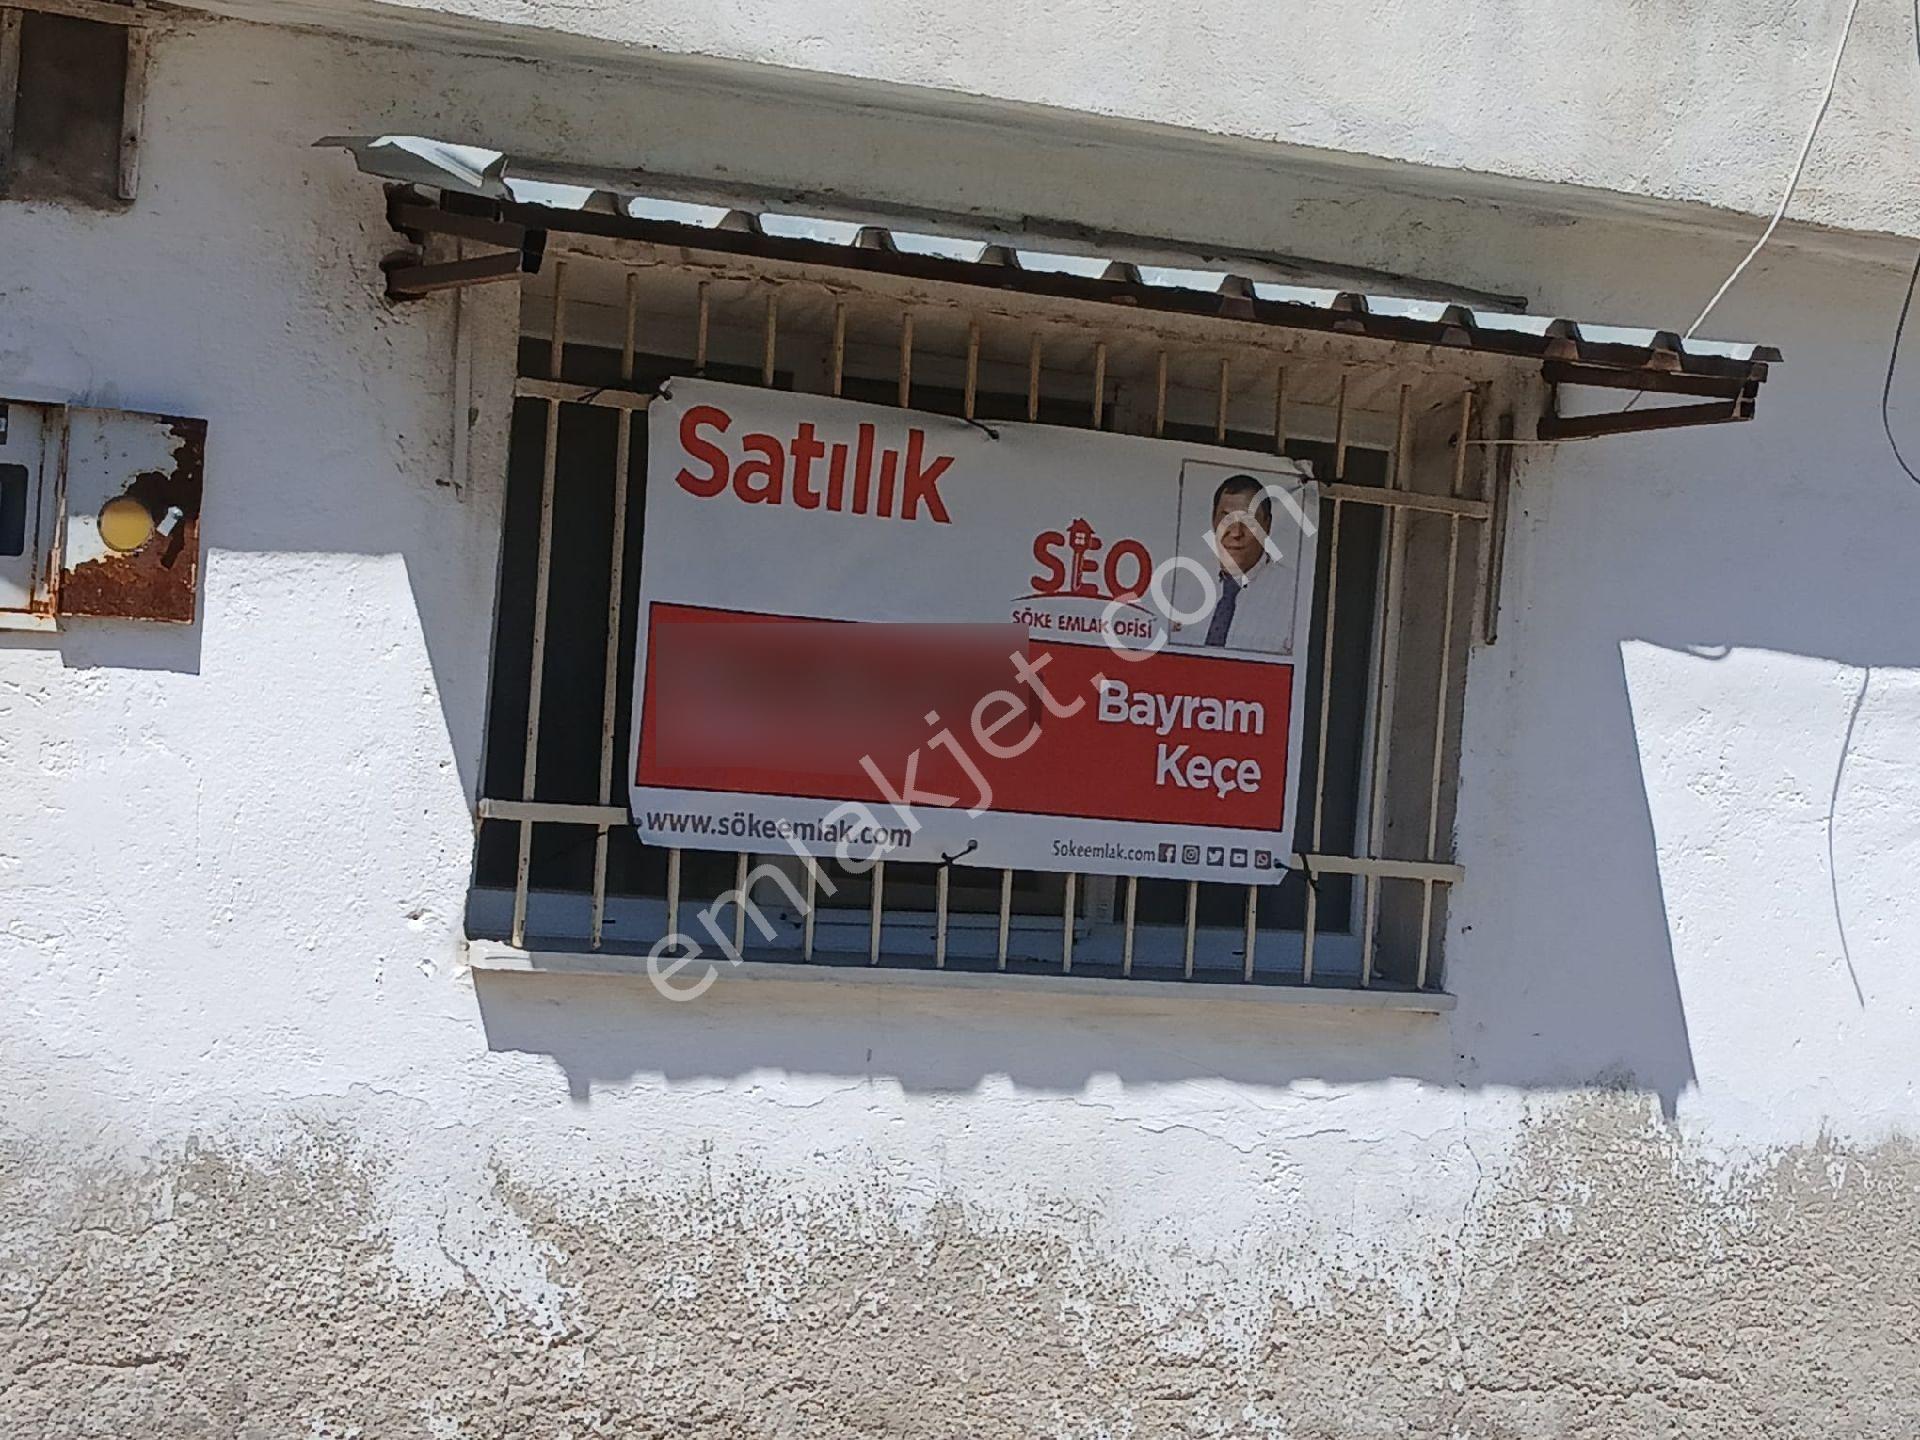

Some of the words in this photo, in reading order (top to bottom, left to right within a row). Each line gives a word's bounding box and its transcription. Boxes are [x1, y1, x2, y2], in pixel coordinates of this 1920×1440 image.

[675, 405, 954, 524] Satılık
[1031, 517, 1153, 601] SEO
[1012, 608, 1052, 628] SÖKE
[1058, 615, 1109, 634] EMLAK
[1097, 679, 1265, 736] Bayram
[1155, 743, 1262, 799] Keçe
[646, 810, 912, 848] www.sökeemlak.com
[1052, 839, 1156, 863] Sokeemlak.com
